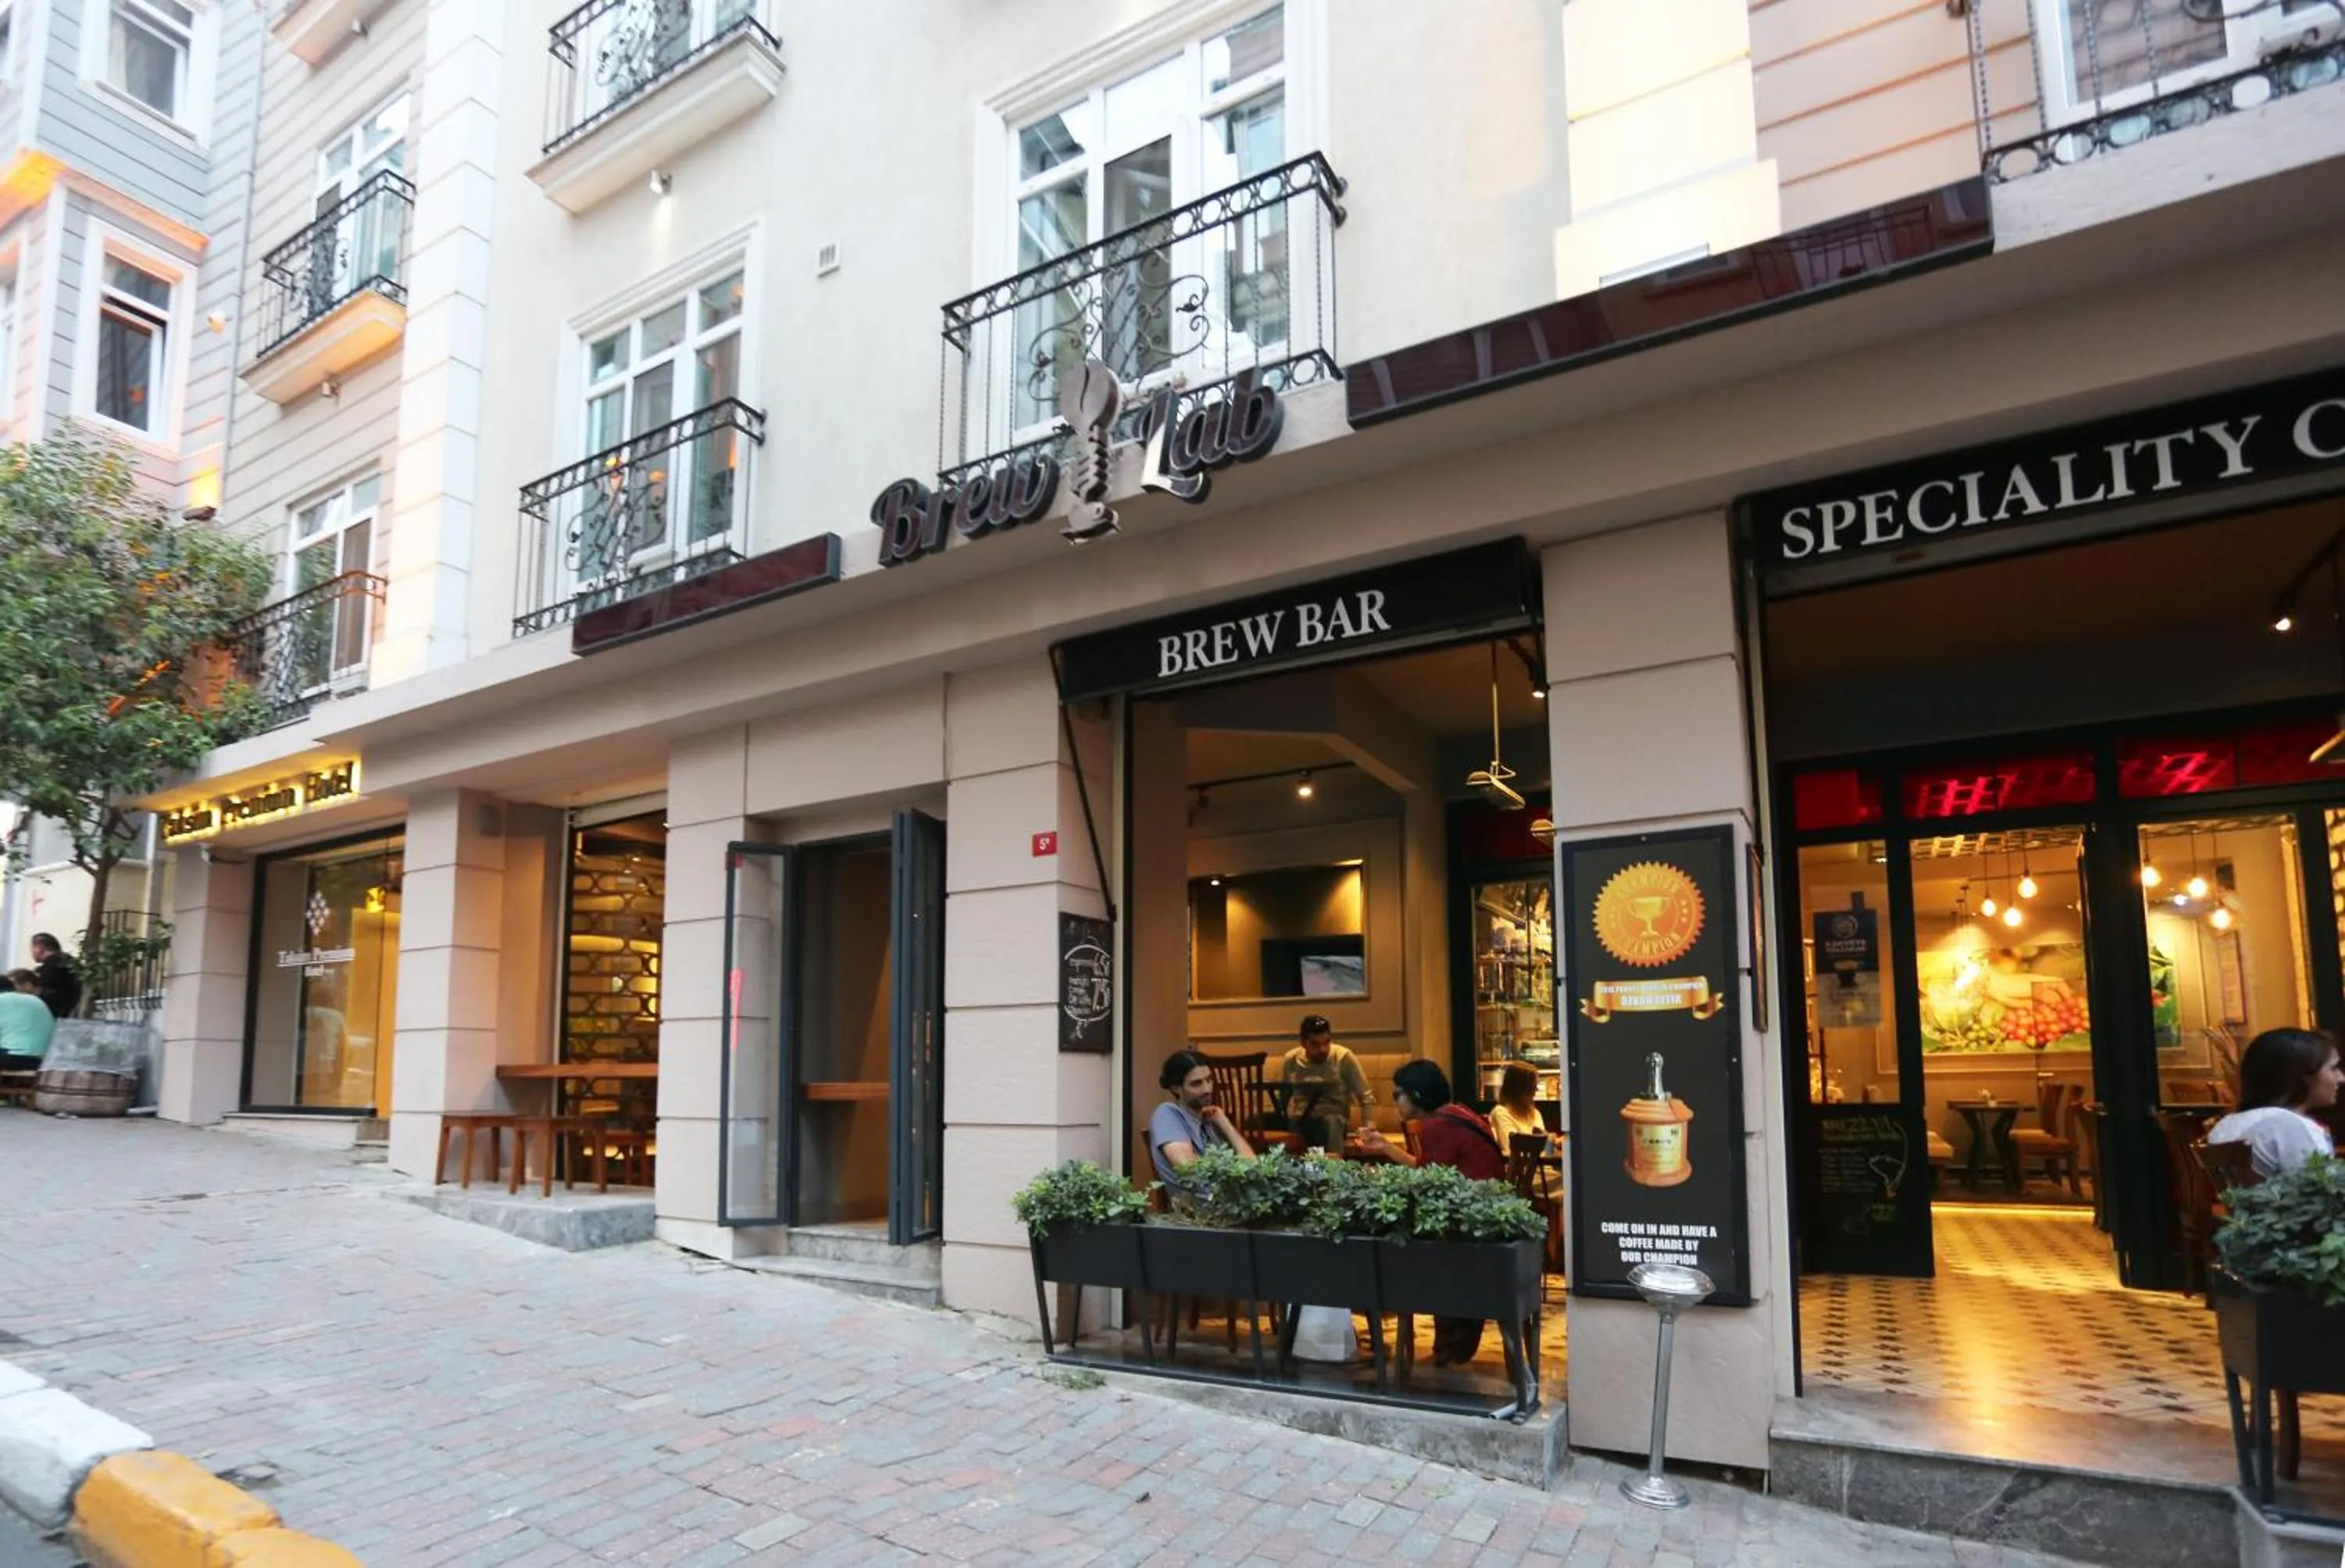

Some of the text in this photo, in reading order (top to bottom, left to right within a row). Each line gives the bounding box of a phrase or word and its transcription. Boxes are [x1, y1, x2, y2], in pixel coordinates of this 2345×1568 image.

[870, 367, 1284, 567] Brew Lab
[1781, 414, 2262, 560] SPECIALITY
[1158, 589, 1392, 678] BREW BAR
[306, 761, 354, 803] Hotel
[1601, 1222, 1718, 1238] COME ON IN AND HAVE A
[1619, 1237, 1699, 1251] COFFEE MADE BY
[1620, 1250, 1698, 1265] OUR CHAMPION
